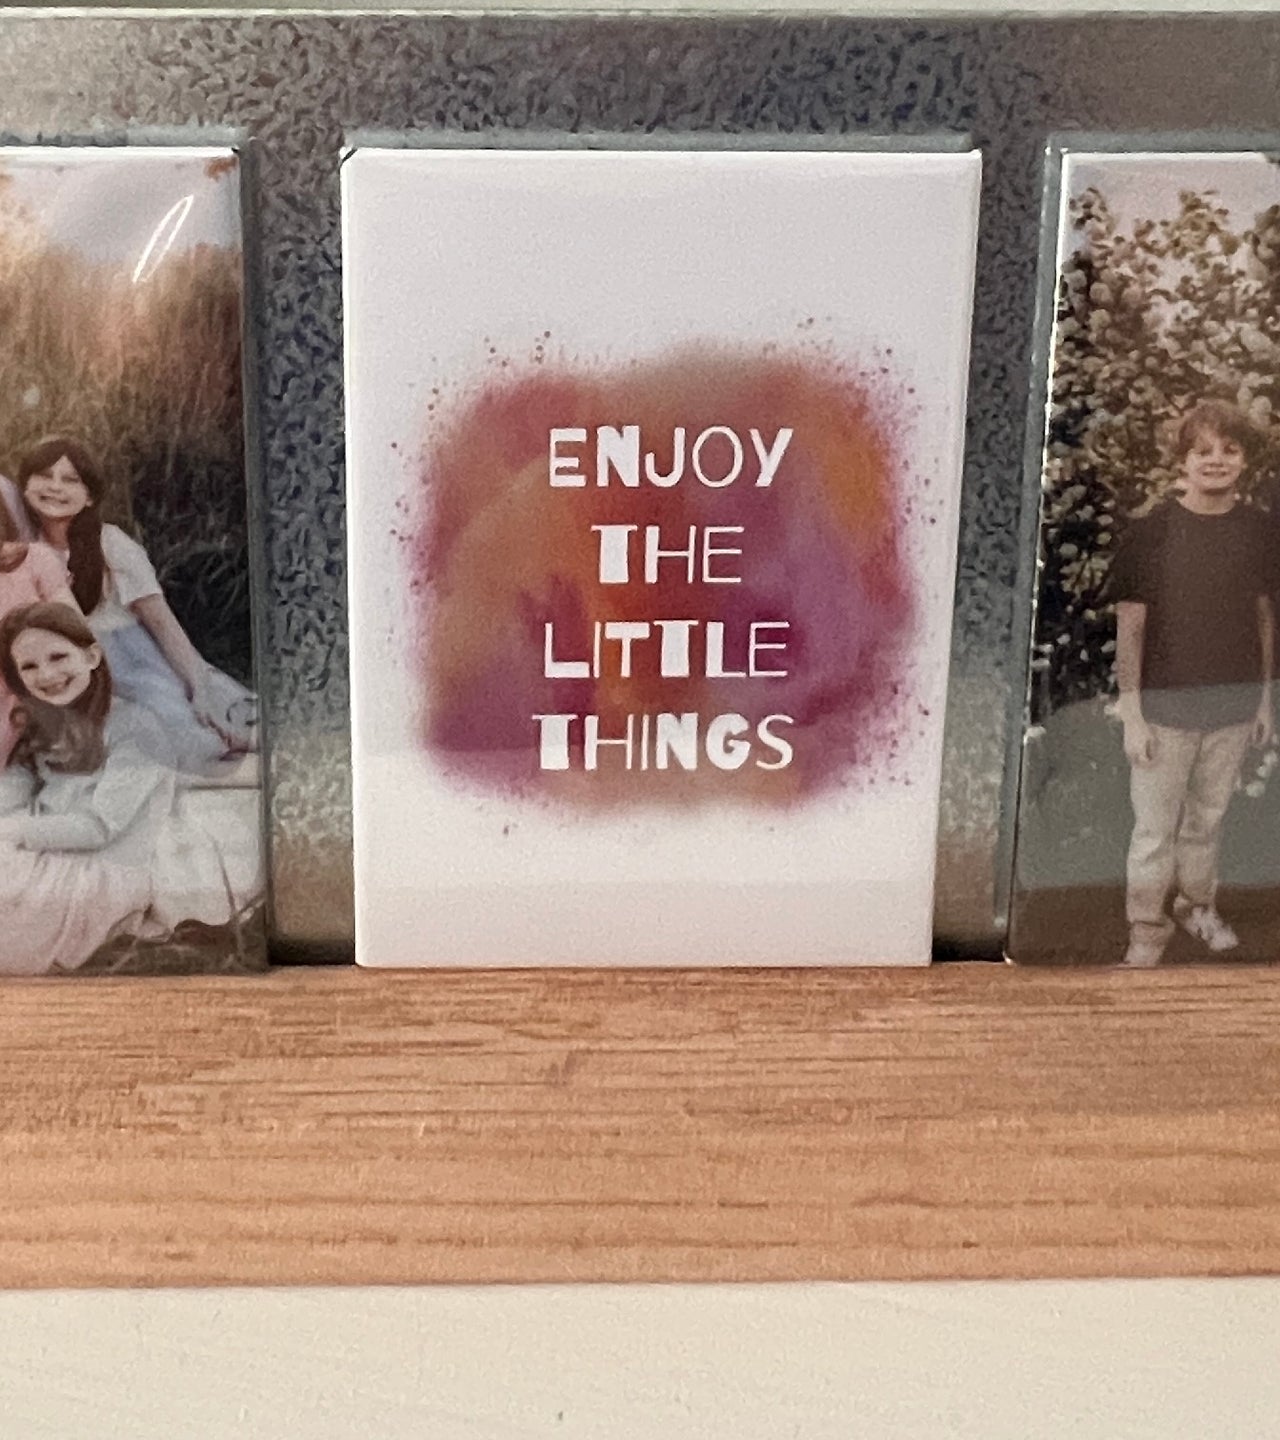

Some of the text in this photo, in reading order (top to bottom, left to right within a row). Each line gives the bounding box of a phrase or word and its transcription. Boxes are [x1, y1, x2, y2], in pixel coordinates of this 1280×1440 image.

[548, 425, 794, 489] ENJOY
[590, 524, 746, 584] THE
[543, 620, 791, 679] LITTLE
[531, 713, 796, 772] THINGS
